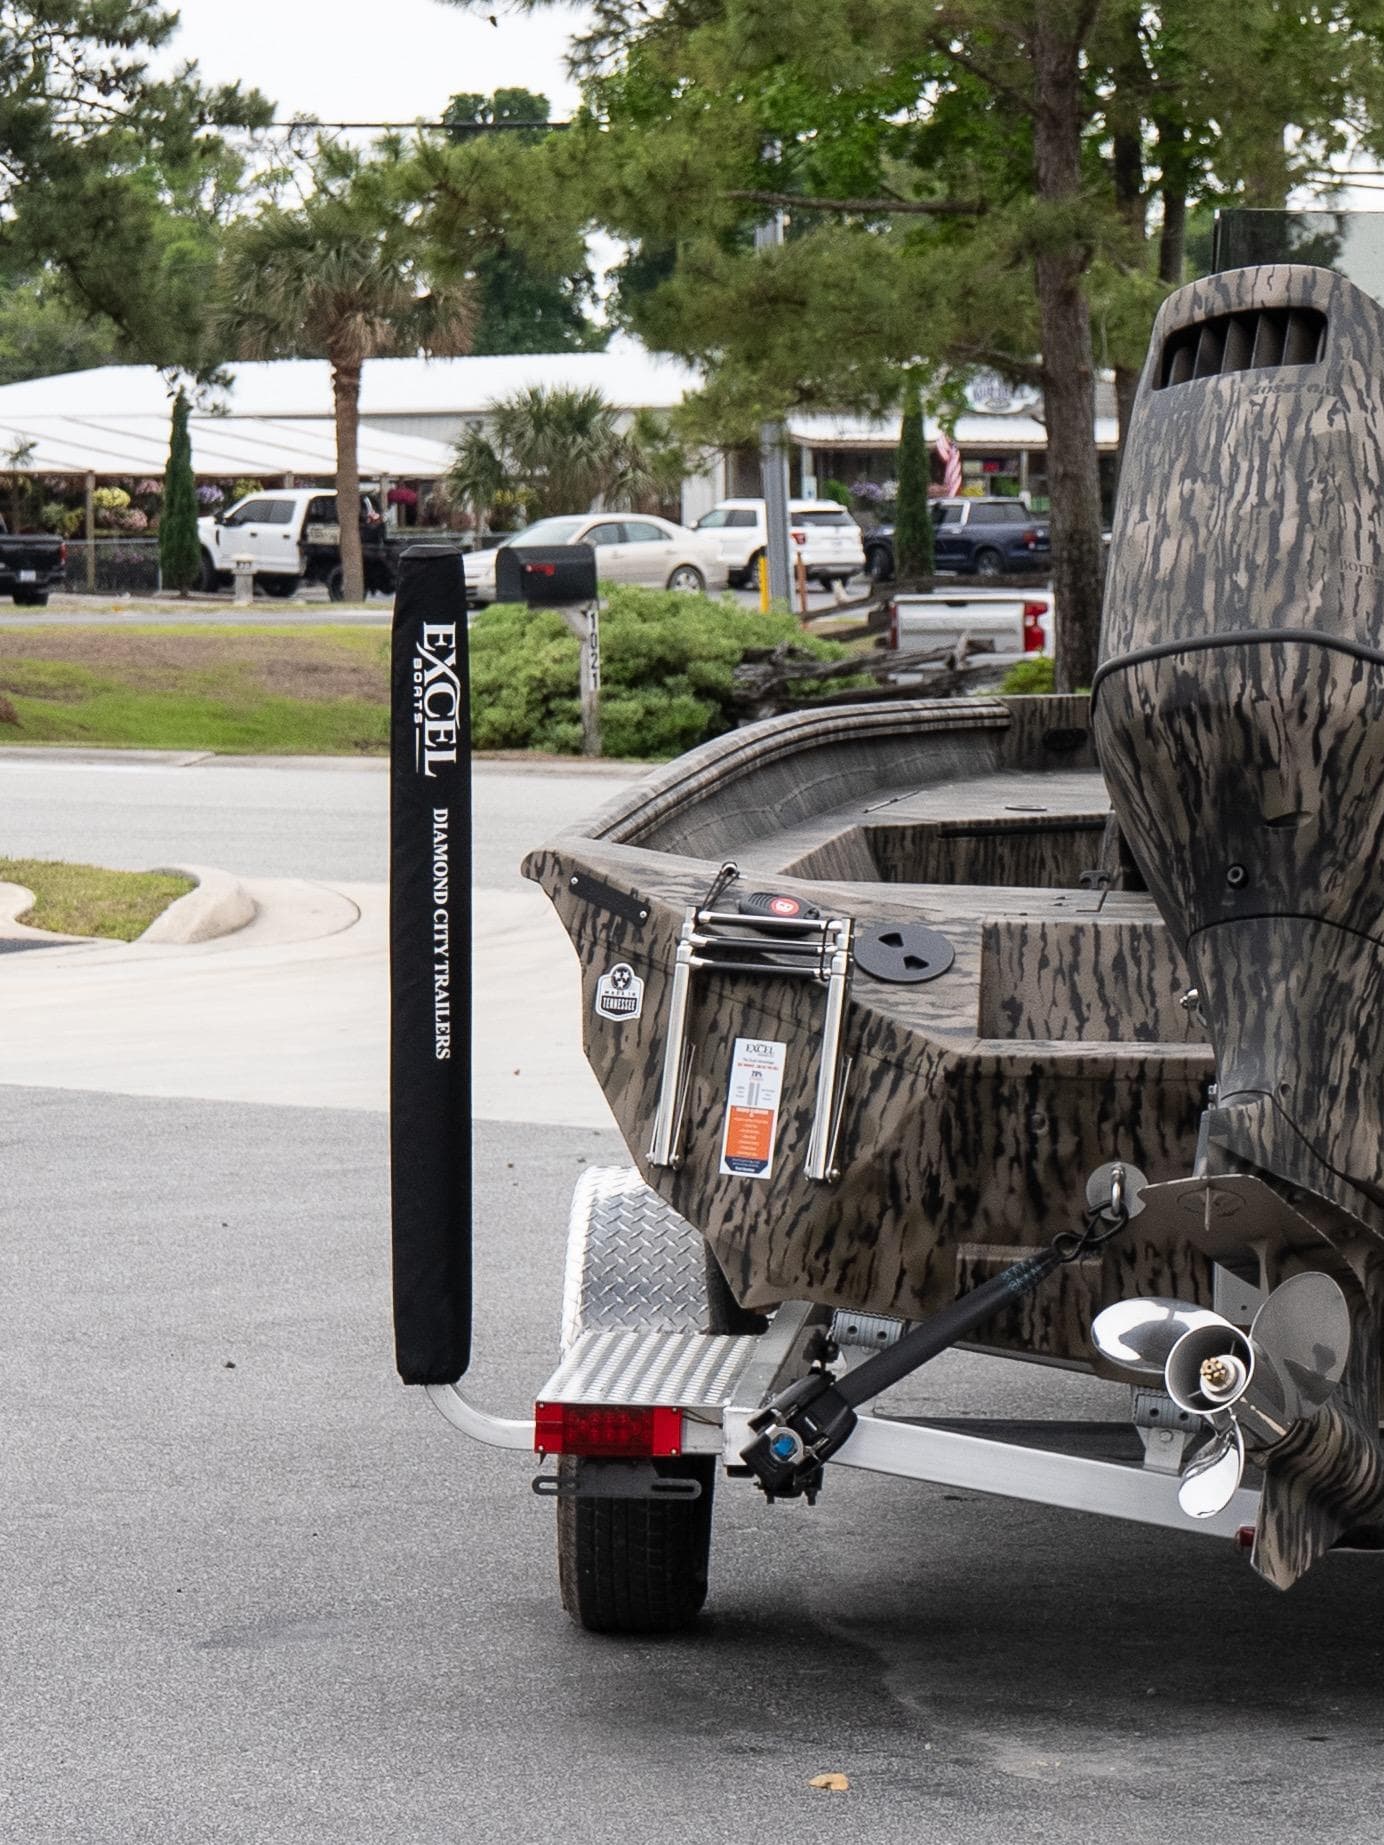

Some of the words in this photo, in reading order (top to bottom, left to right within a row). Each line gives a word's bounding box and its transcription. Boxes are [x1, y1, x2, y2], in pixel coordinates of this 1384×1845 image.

[412, 657, 423, 724] BOATS
[416, 621, 461, 778] EXCEL
[432, 808, 449, 905] DIAMOND
[433, 908, 450, 962] CITY
[433, 963, 451, 1060] TRAILERS
[602, 996, 636, 1011] TENNESSEE
[746, 1043, 775, 1055] EXCEL
